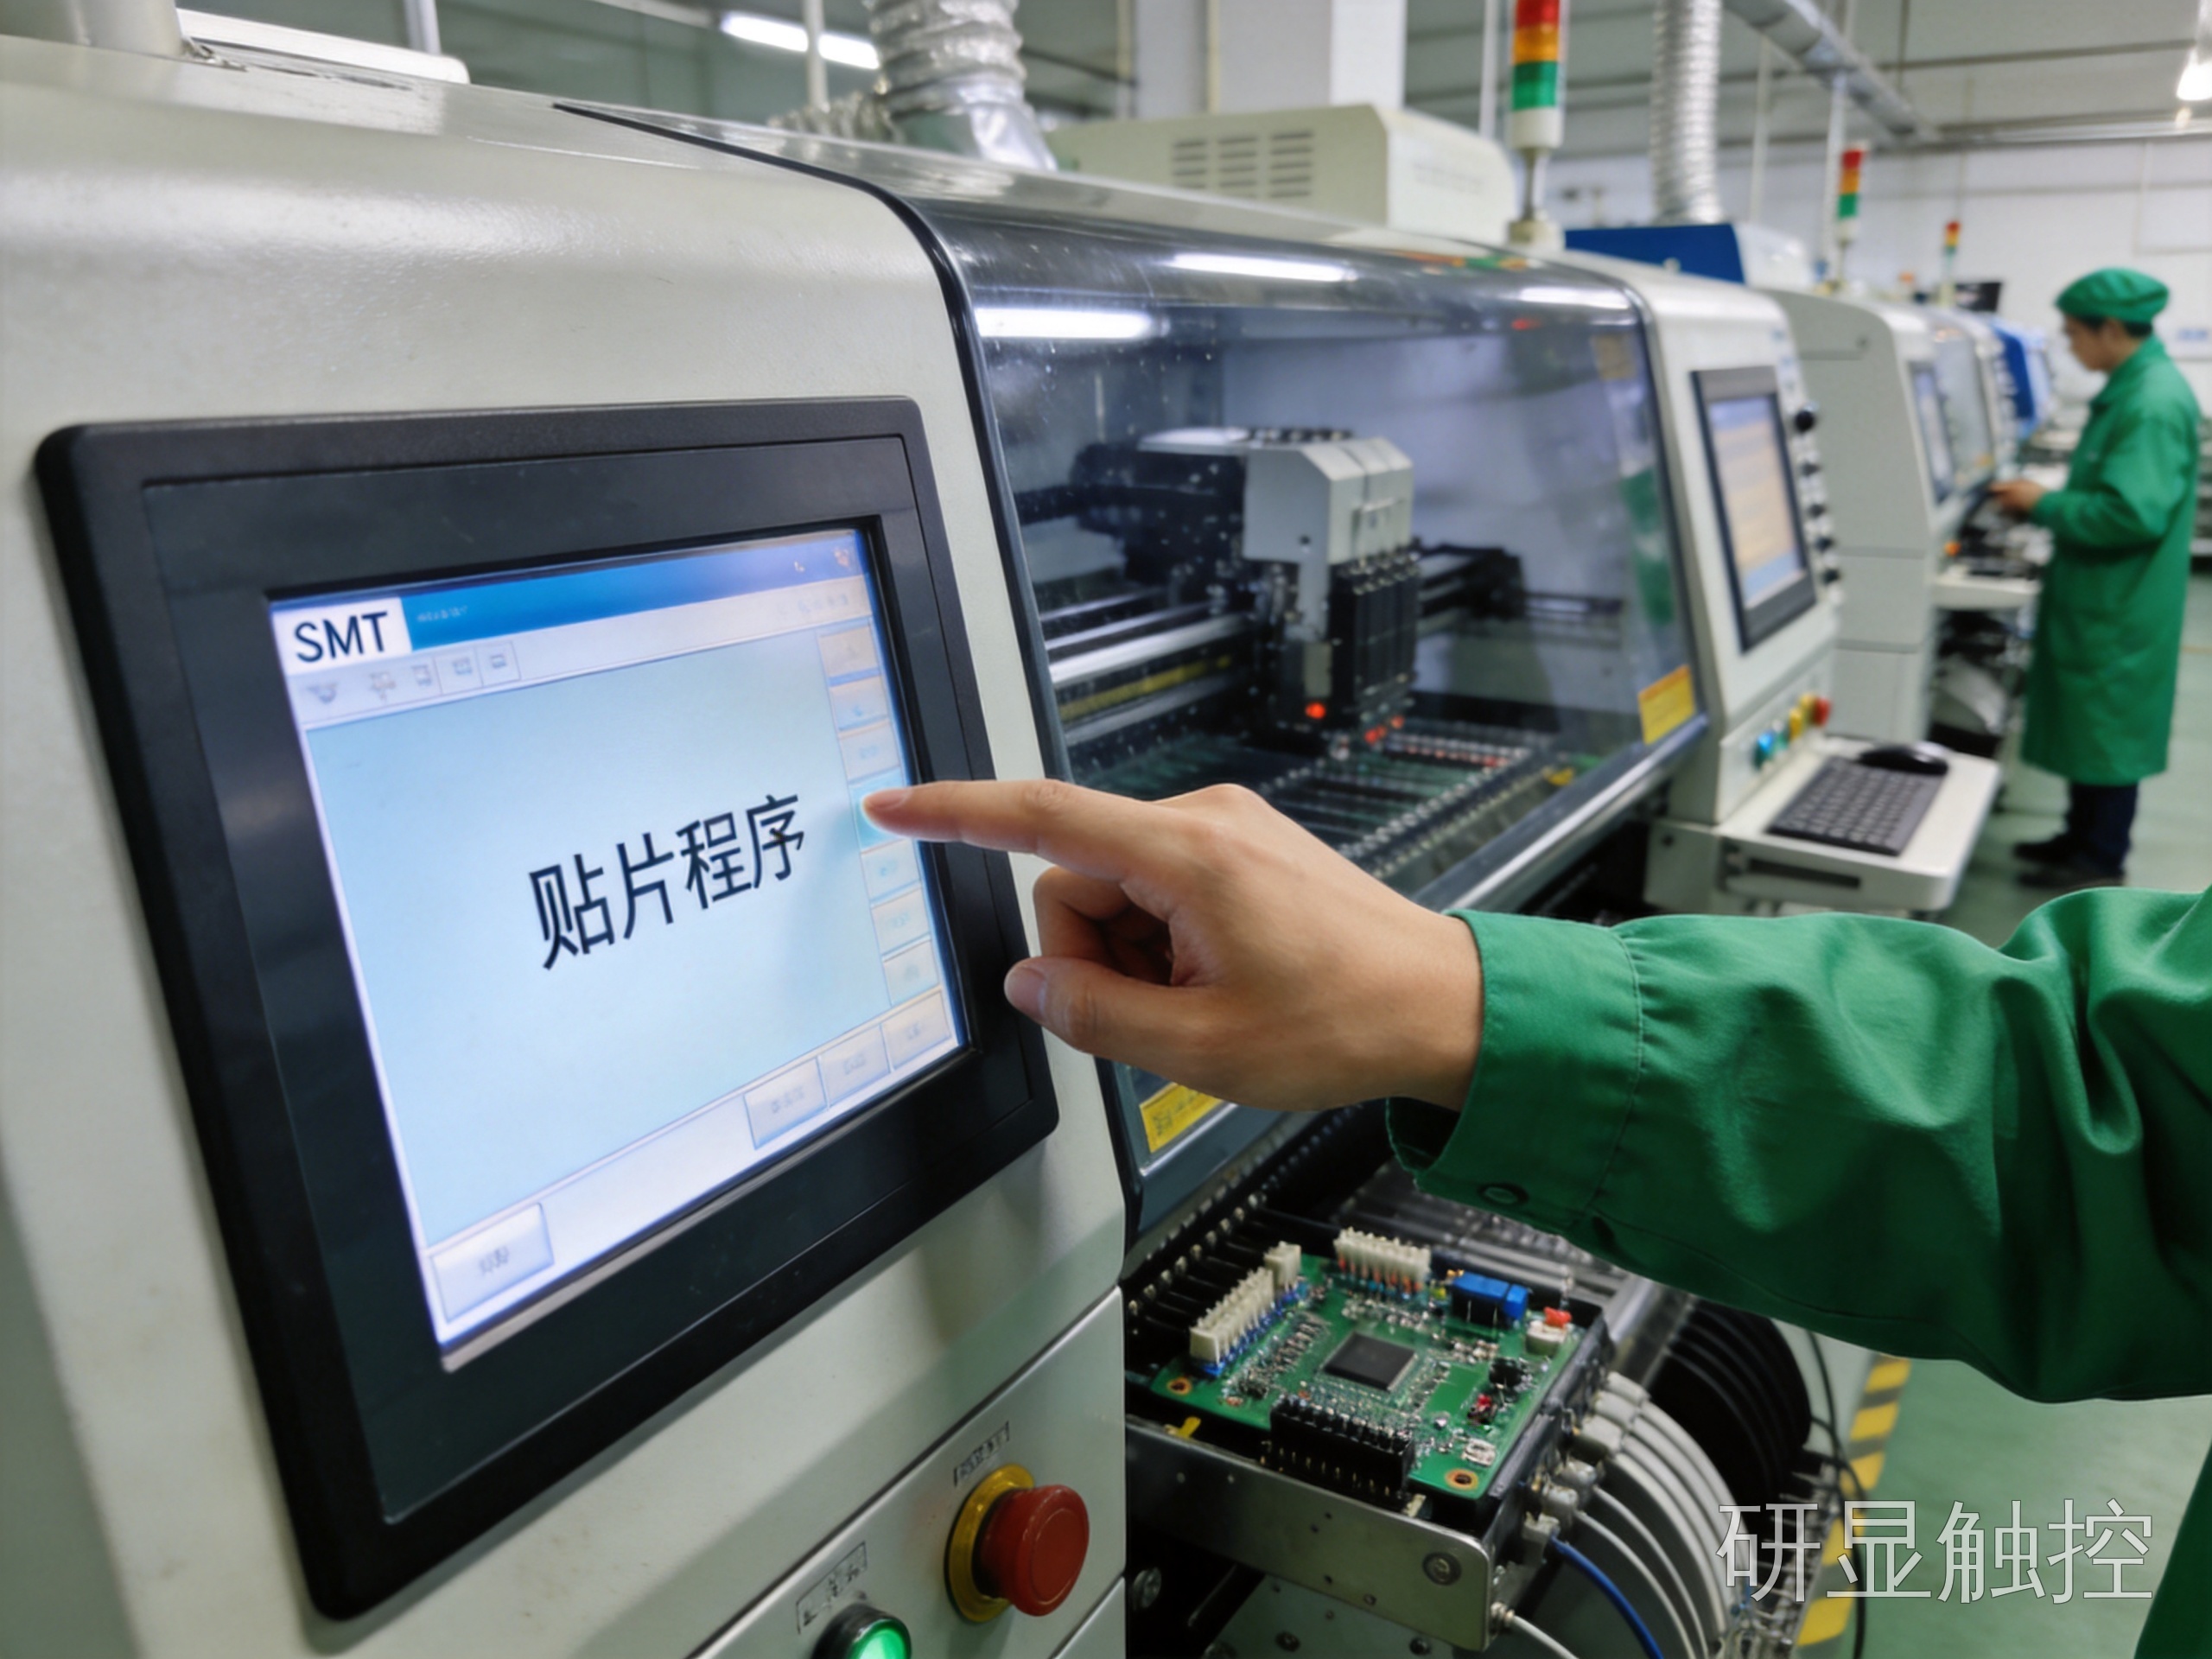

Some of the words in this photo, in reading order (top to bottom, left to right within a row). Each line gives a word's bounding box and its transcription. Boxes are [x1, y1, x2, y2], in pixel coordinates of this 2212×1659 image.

[294, 611, 389, 664] SMT
[529, 794, 804, 970] 贴片程序
